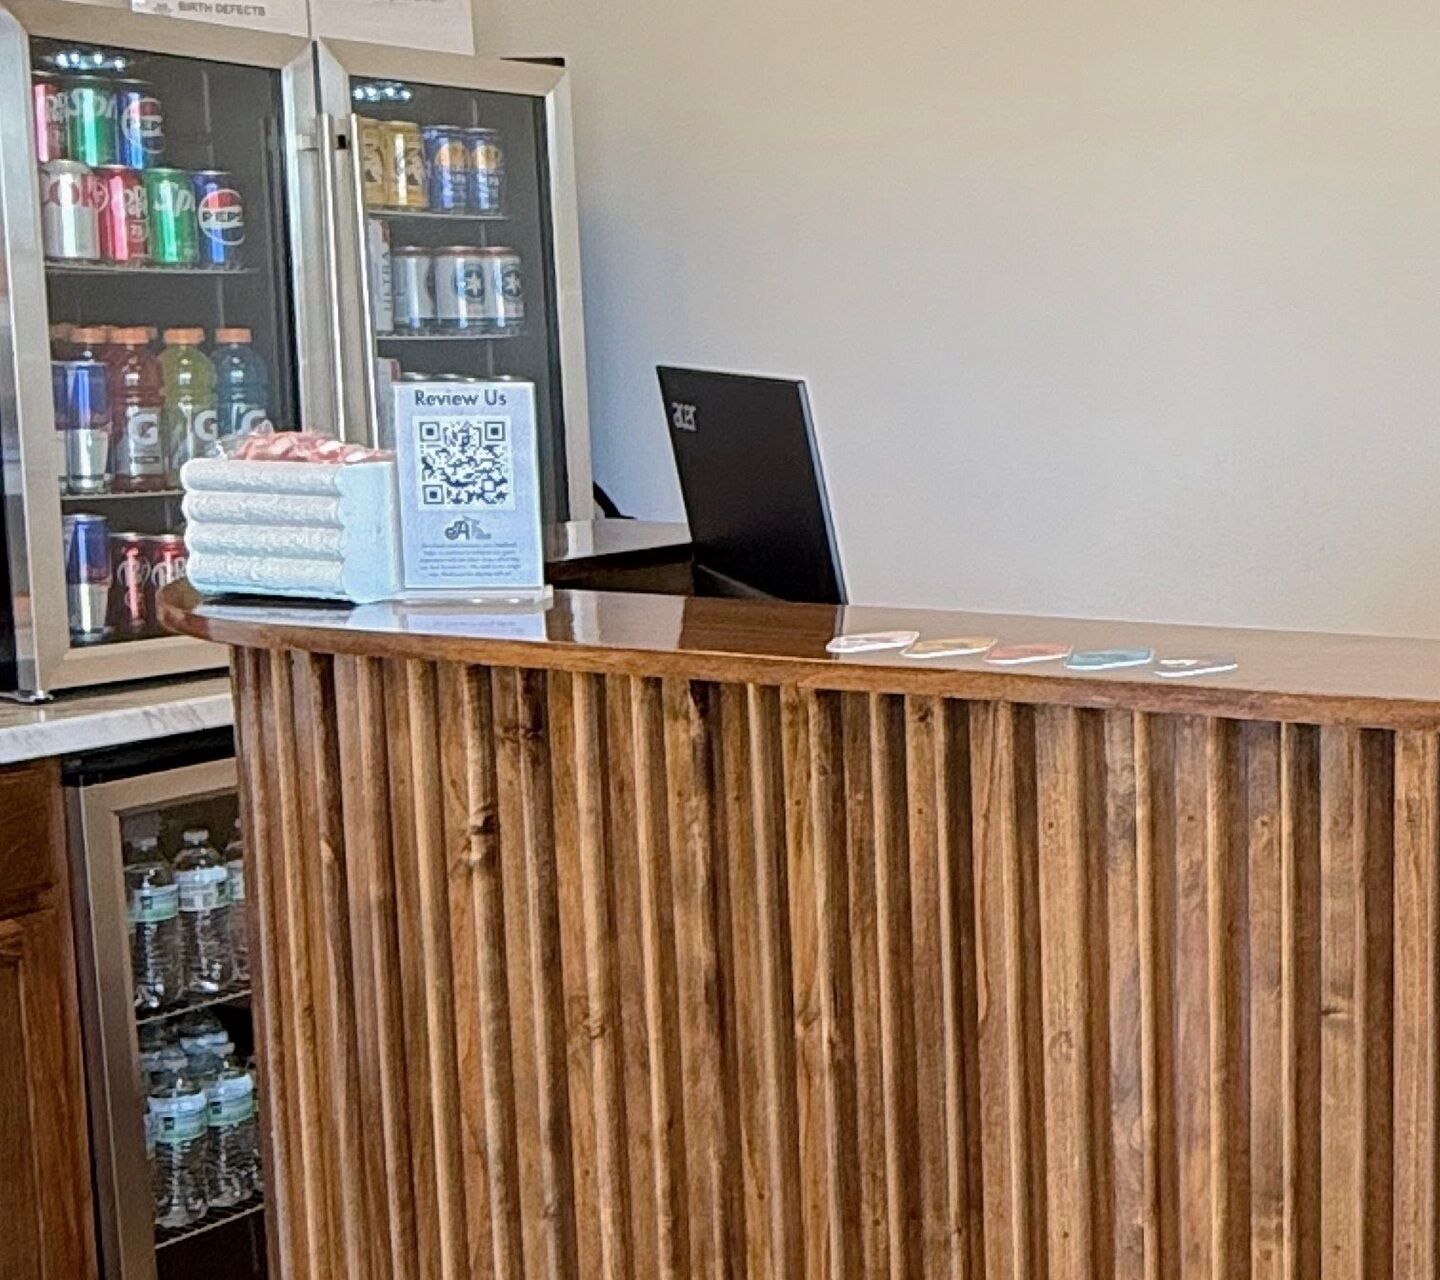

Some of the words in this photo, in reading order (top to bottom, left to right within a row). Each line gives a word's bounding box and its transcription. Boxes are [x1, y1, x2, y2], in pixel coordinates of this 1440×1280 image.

[178, 1, 213, 13] BIRTH
[215, 3, 266, 16] DEFECTS
[414, 389, 480, 406] Review
[484, 389, 507, 406] Us
